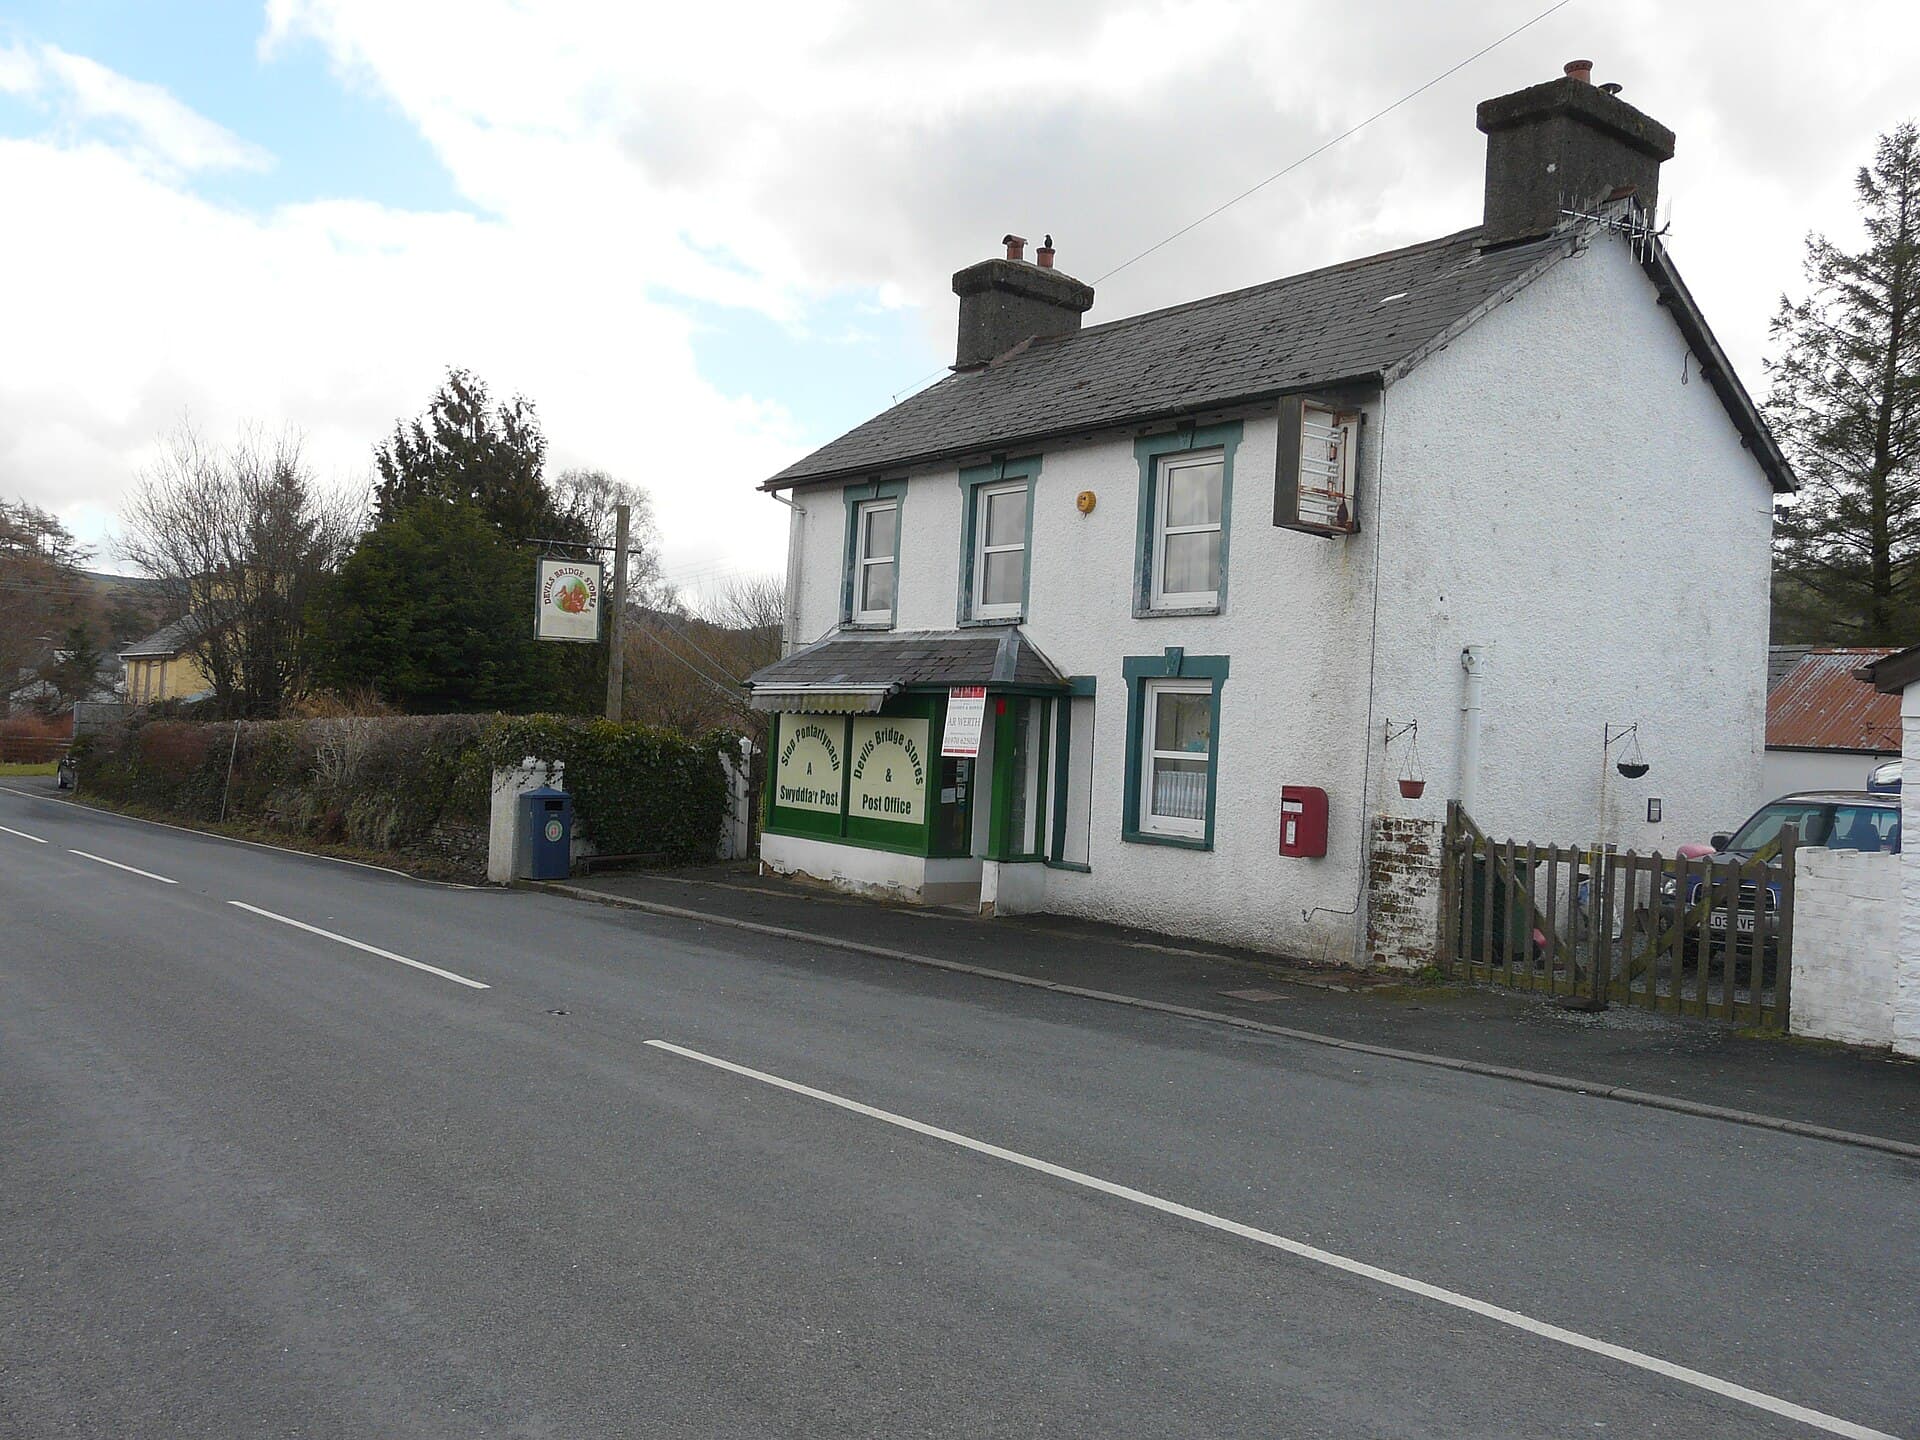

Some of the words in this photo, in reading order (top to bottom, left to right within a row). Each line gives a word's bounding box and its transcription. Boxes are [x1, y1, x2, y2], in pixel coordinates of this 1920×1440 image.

[544, 577, 555, 605] DEVILS
[554, 568, 585, 578] BRIDGE
[584, 577, 597, 608] STORES
[875, 727, 905, 746] Bridge
[904, 739, 923, 786] Stores
[806, 761, 813, 776] A
[885, 767, 893, 783] &
[820, 789, 839, 808] Post
[862, 793, 882, 812] Post
[884, 796, 911, 815] Office
